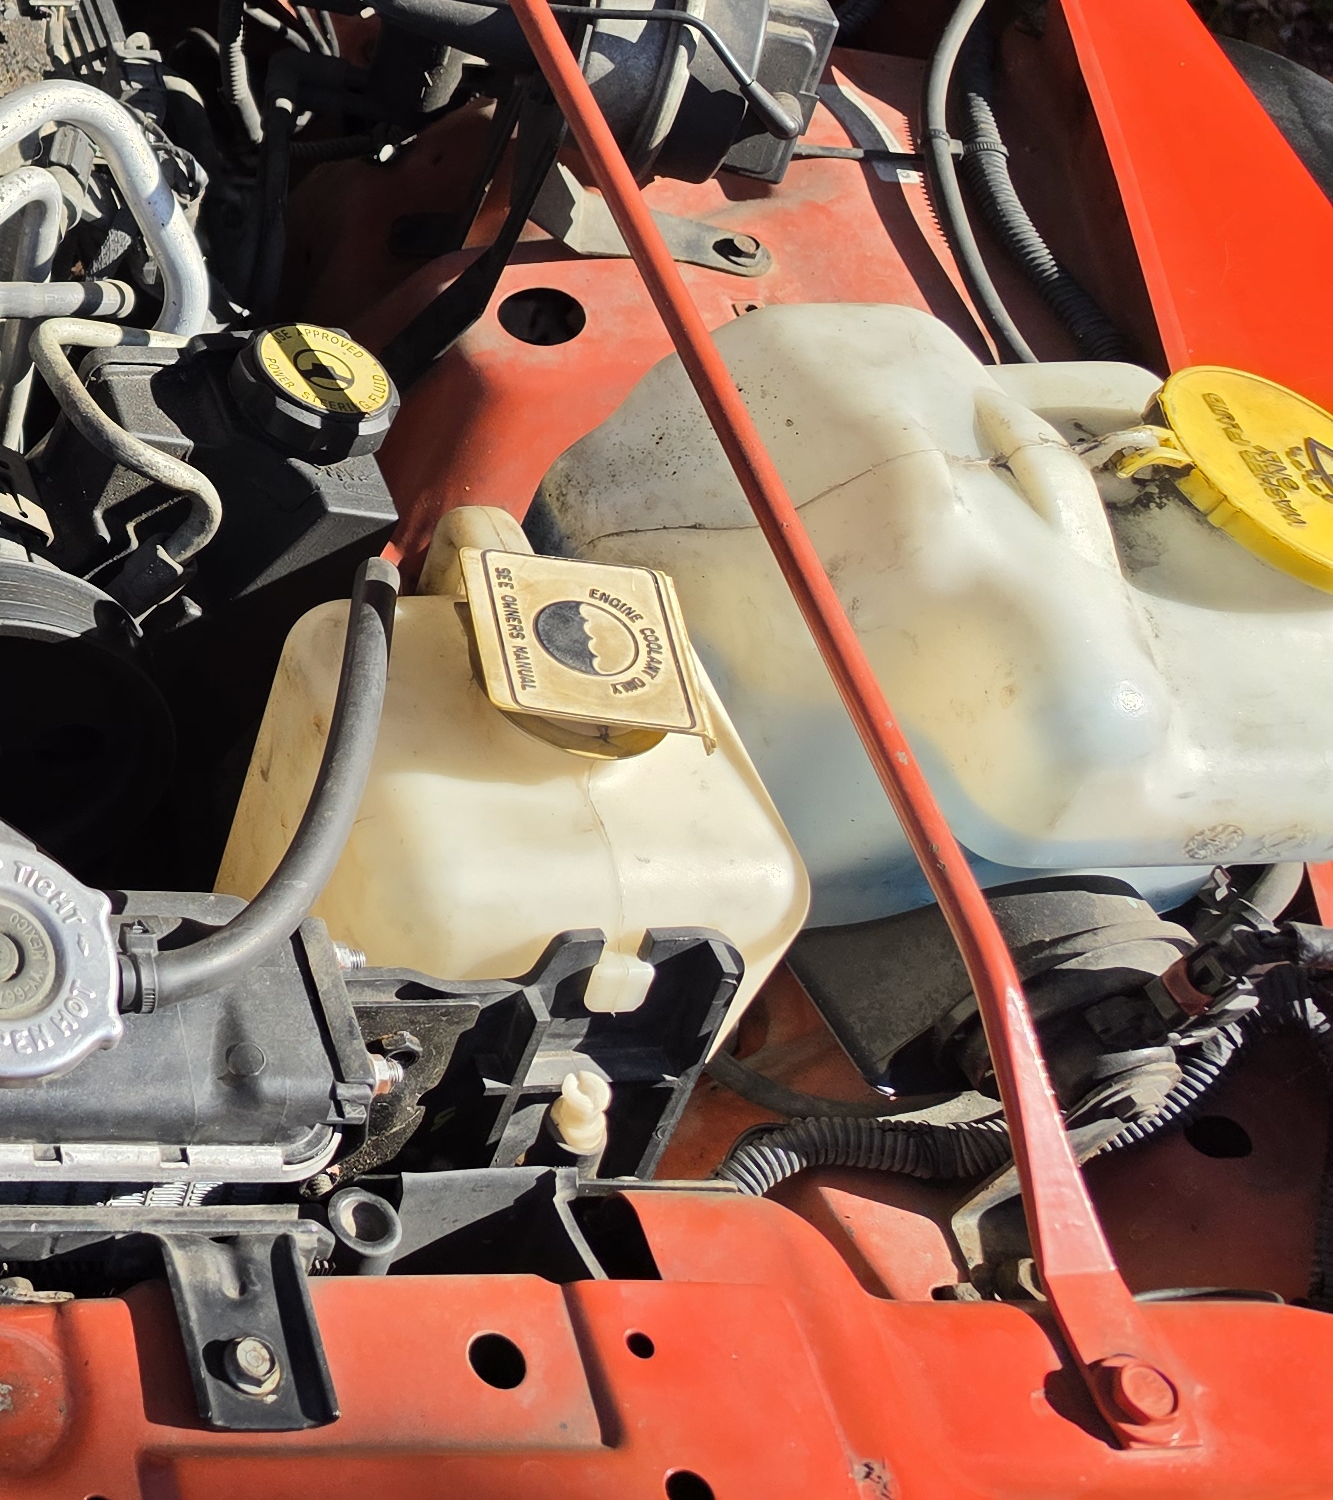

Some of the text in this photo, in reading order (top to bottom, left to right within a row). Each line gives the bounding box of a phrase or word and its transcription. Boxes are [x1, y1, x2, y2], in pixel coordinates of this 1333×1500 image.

[272, 328, 365, 359] USE APPROVED
[264, 357, 386, 413] POWER STEERING FLUID
[1238, 448, 1308, 527] WASHER
[1255, 444, 1300, 492] ONLY
[495, 566, 537, 692] SEE OWNERS MANUAL
[589, 587, 664, 696] ENGINE COOLANT ONLY
[13, 859, 86, 925] TIGHT
[9, 912, 48, 960] MEXICO
[50, 979, 97, 1038] HOT
